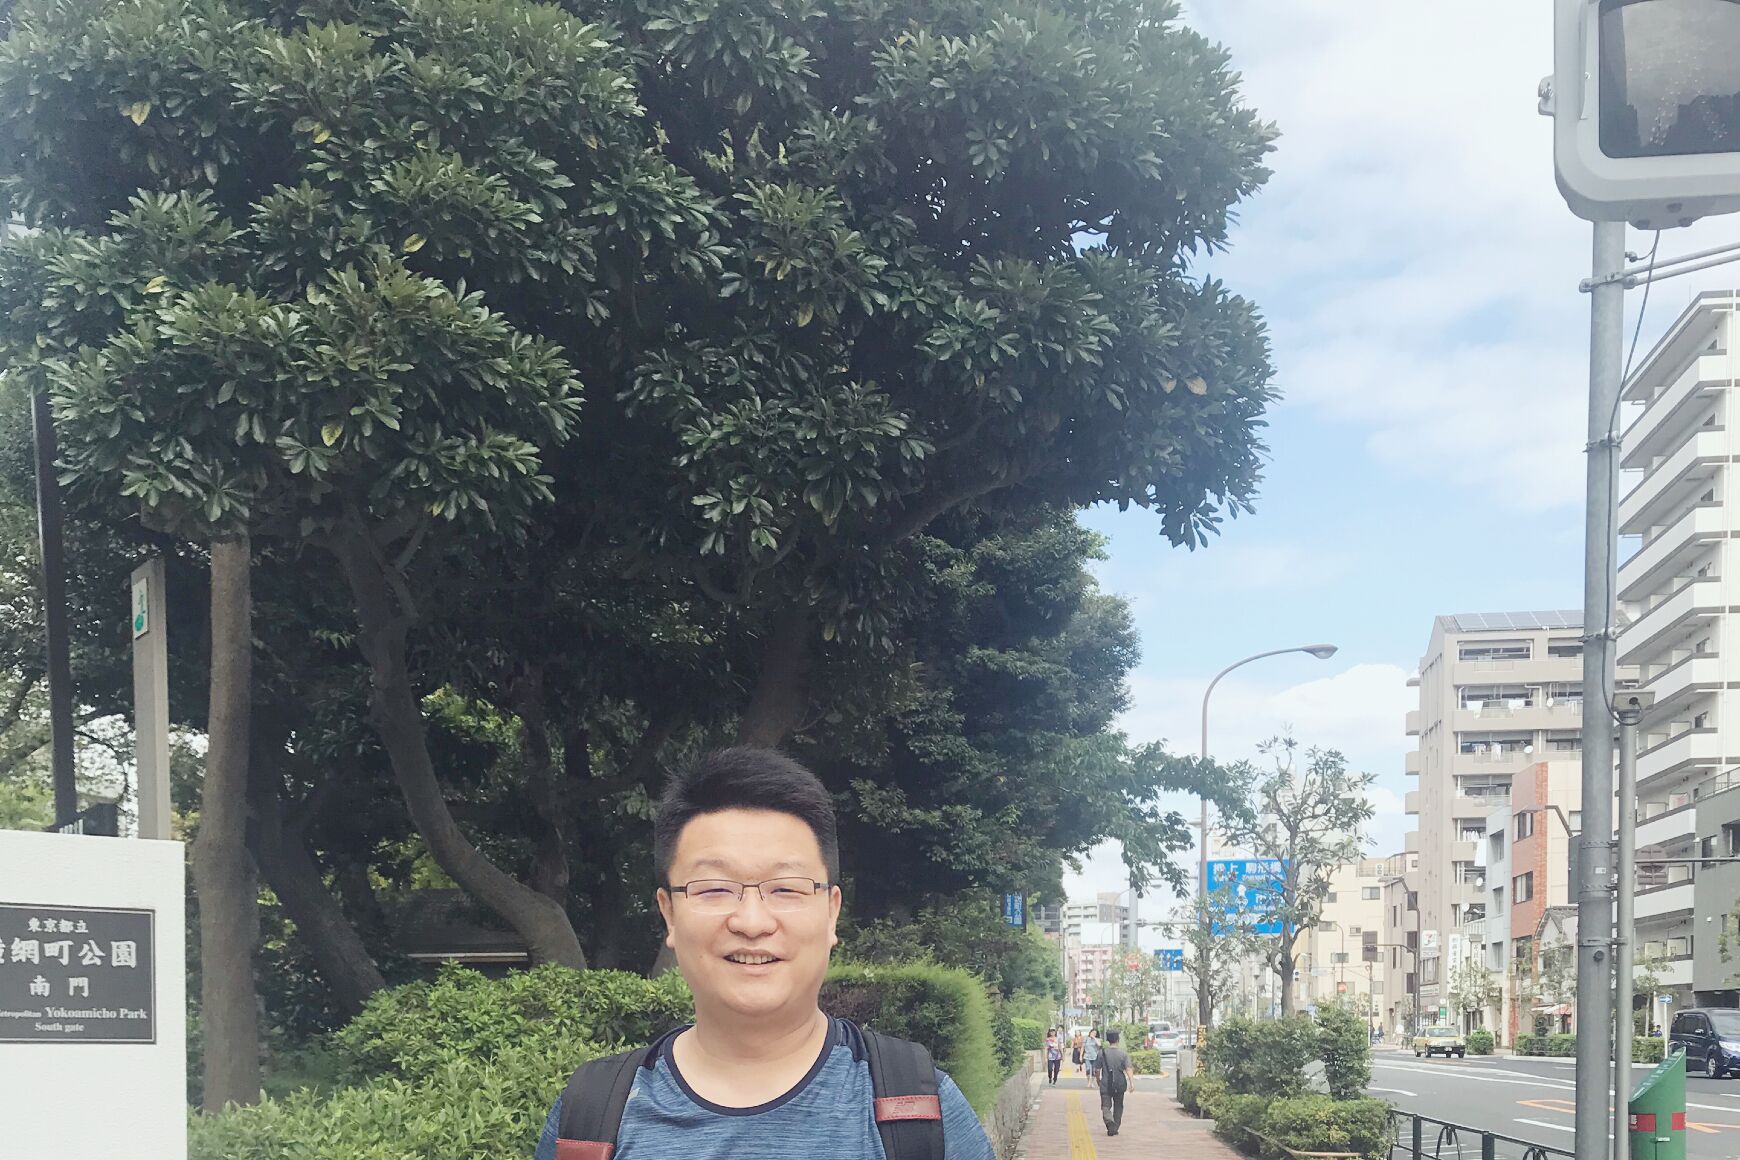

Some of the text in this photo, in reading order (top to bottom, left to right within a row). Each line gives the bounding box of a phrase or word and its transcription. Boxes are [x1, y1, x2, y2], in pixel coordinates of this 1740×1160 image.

[28, 917, 89, 933] 東京都立
[0, 1007, 148, 1019] etropolitan Yokoamicho Park
[35, 1022, 85, 1033] South gate
